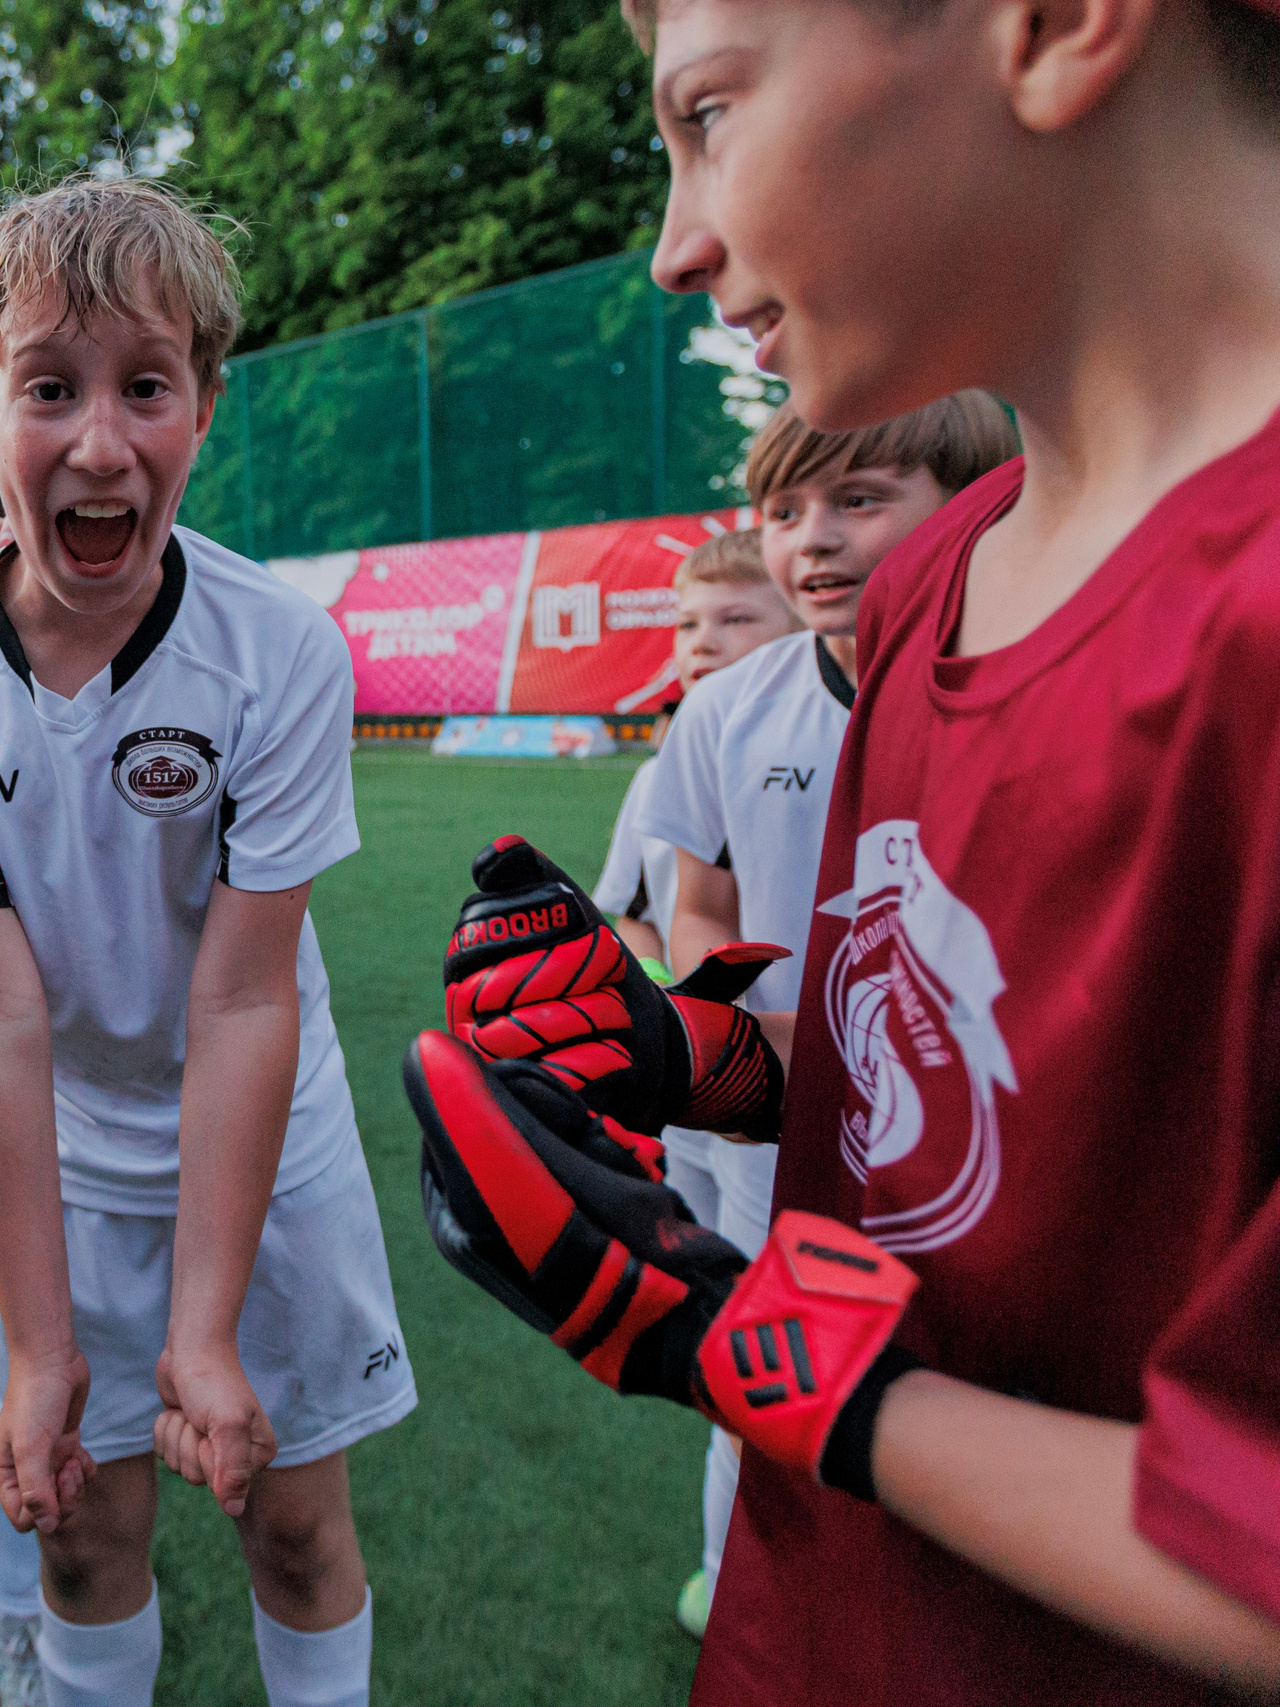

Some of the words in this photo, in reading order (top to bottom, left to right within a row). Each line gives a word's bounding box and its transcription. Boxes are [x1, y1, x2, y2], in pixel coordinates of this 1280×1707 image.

[139, 730, 185, 740] СТАРТ
[143, 771, 180, 783] 1517
[447, 903, 568, 957] BROOKLY
